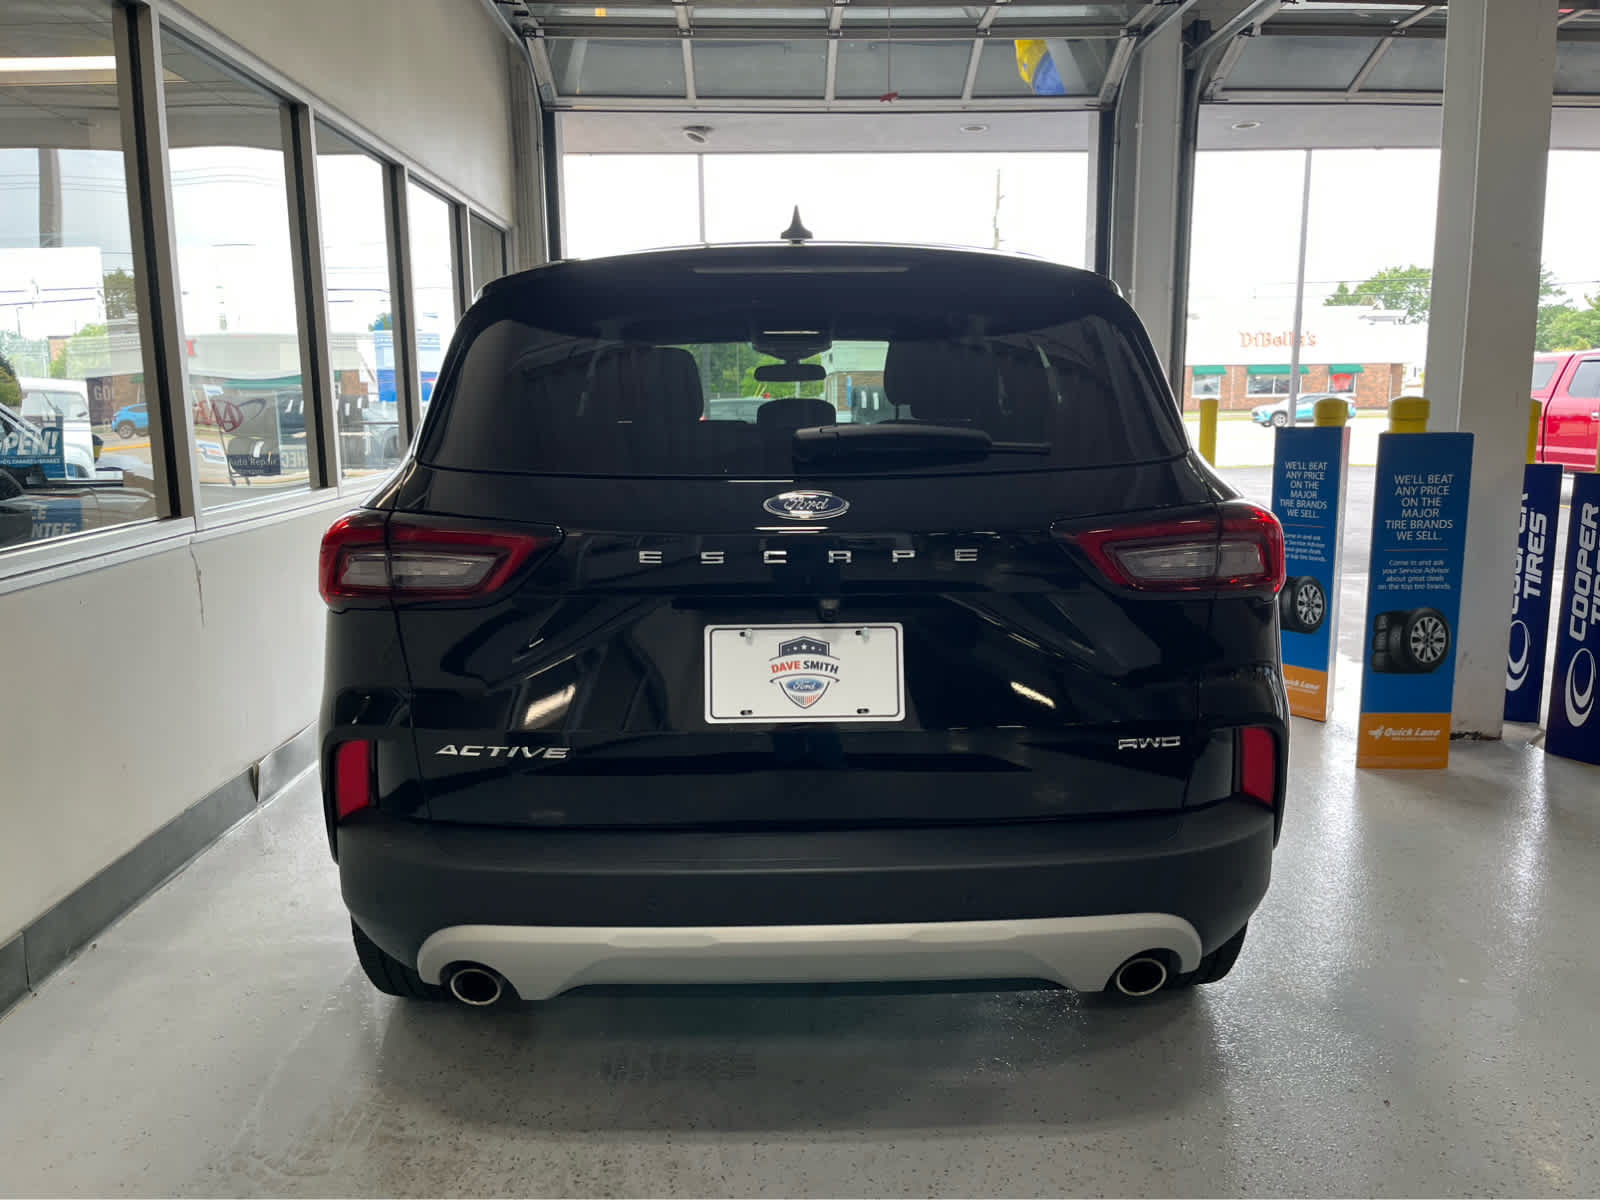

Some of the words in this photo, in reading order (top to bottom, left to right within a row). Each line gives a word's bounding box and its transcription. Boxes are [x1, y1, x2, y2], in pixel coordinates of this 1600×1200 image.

[0, 431, 59, 455] PEN!
[1308, 462, 1328, 470] BEAT
[1286, 471, 1302, 479] ANY
[1304, 471, 1325, 480] PRICE
[1394, 474, 1424, 485] WE'LL
[1427, 473, 1455, 484] BEAT
[1290, 480, 1303, 489] ON
[1304, 481, 1320, 489] THE
[1290, 490, 1318, 499] MAJOR
[1394, 486, 1418, 497] ANY
[1420, 485, 1450, 496] PRICE
[1280, 499, 1294, 507] TIRE
[1296, 500, 1327, 509] BRANDS
[1401, 497, 1418, 507] ON
[1422, 497, 1443, 507] THE
[1287, 508, 1299, 517] WE
[1401, 508, 1440, 518] MAJOR
[1385, 519, 1407, 529] TIRE
[1410, 519, 1453, 529] BRANDS
[1396, 530, 1413, 541] WE
[638, 548, 978, 565] ESCAPE
[1523, 511, 1547, 600] TIRES
[1569, 502, 1599, 642] COOPER
[771, 660, 801, 674] DAVE
[803, 660, 839, 675] SMITH
[1384, 727, 1414, 736] Quick
[1415, 727, 1441, 736] Lane
[1118, 736, 1180, 750] AWD
[434, 744, 571, 759] ACTIVE
